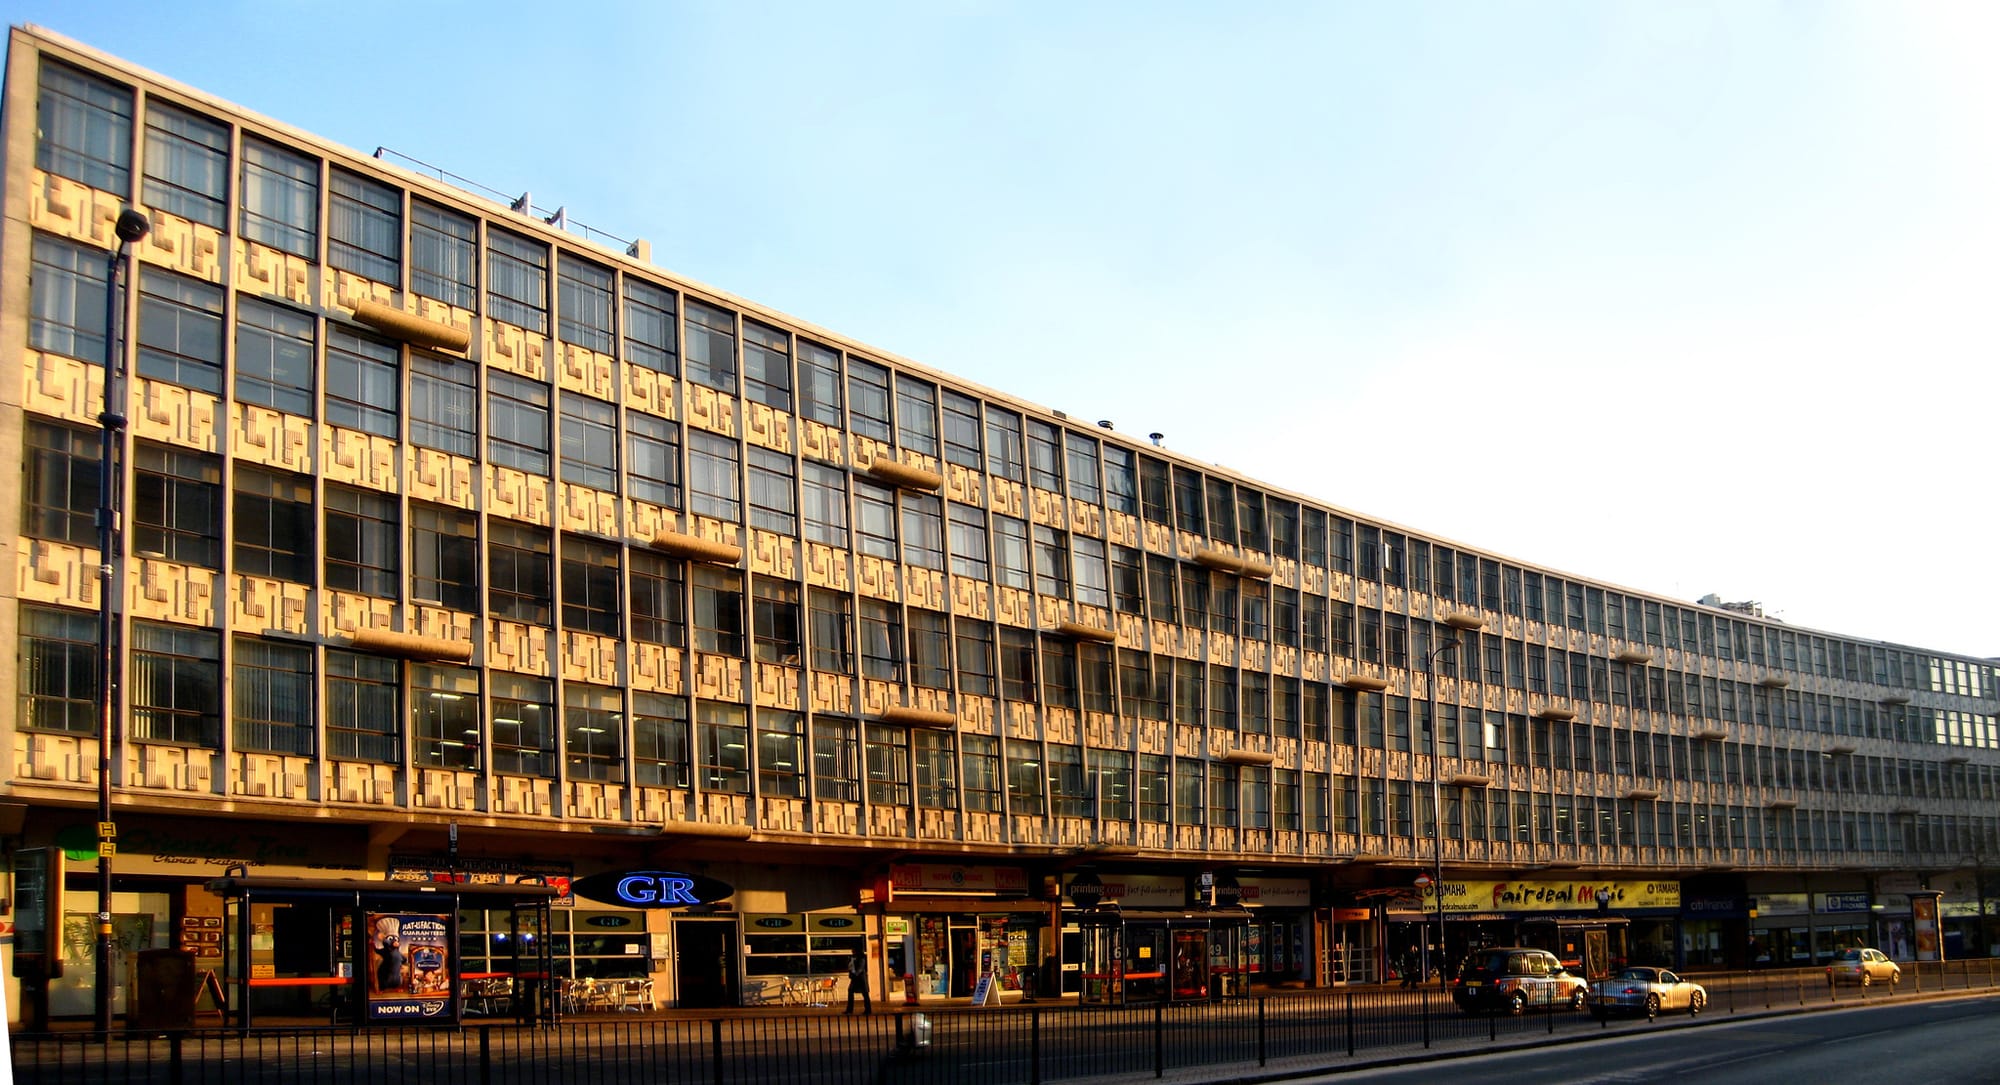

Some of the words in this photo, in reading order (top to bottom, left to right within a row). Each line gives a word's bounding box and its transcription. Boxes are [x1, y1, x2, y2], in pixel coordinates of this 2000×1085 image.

[153, 853, 198, 865] Chinese
[617, 875, 700, 903] GR
[1070, 882, 1124, 896] printing.com
[1440, 885, 1466, 896] AMAHA
[1655, 884, 1680, 896] YAMAHA
[1493, 884, 1572, 908] Fairdeal
[600, 918, 621, 927] GR
[378, 1006, 402, 1014] NOW
[404, 1005, 420, 1013] ON
